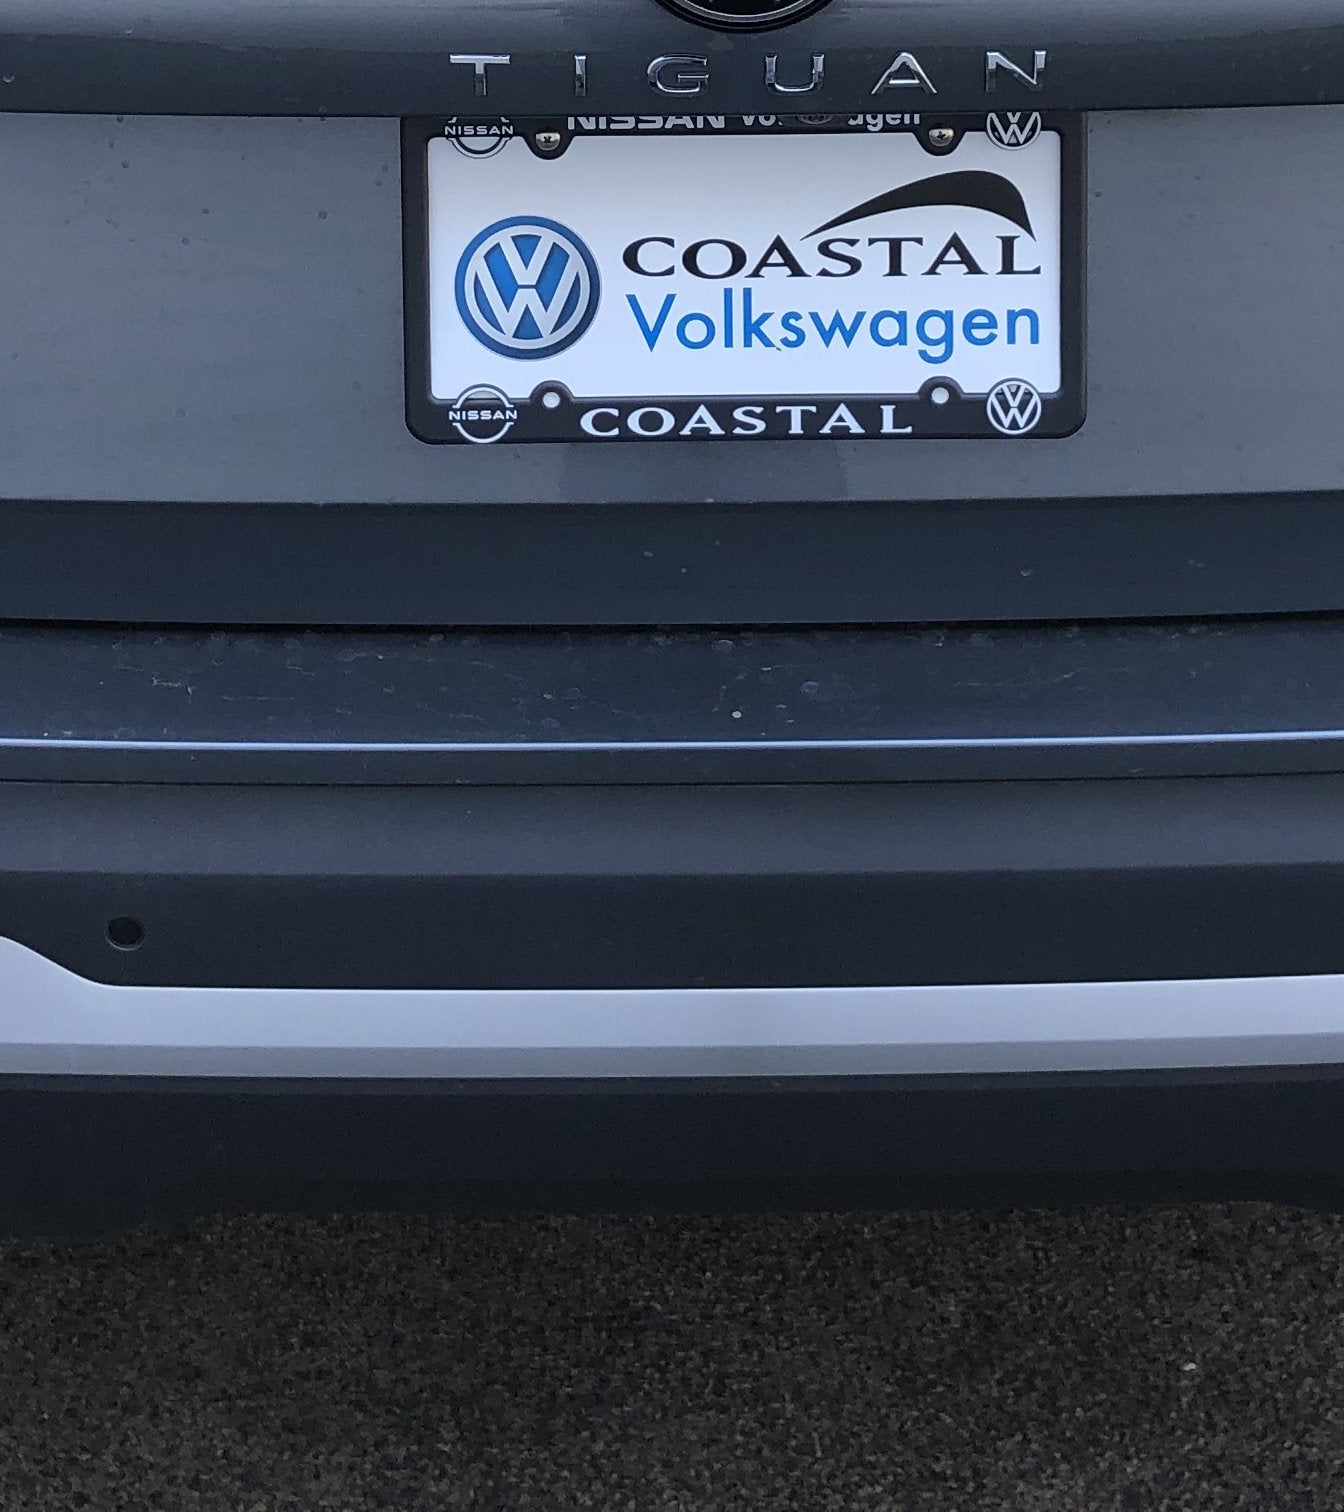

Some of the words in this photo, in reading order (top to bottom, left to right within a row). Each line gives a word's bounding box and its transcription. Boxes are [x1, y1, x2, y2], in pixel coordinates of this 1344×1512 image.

[450, 50, 1047, 95] TIGUAN
[445, 125, 514, 136] NISSAN
[622, 232, 1042, 279] COASTAL
[464, 224, 593, 350] VW
[625, 288, 1040, 364] Volkswagen
[448, 409, 518, 420] NISSAN
[579, 402, 913, 437] COASTAL
[987, 381, 1041, 435] VW
